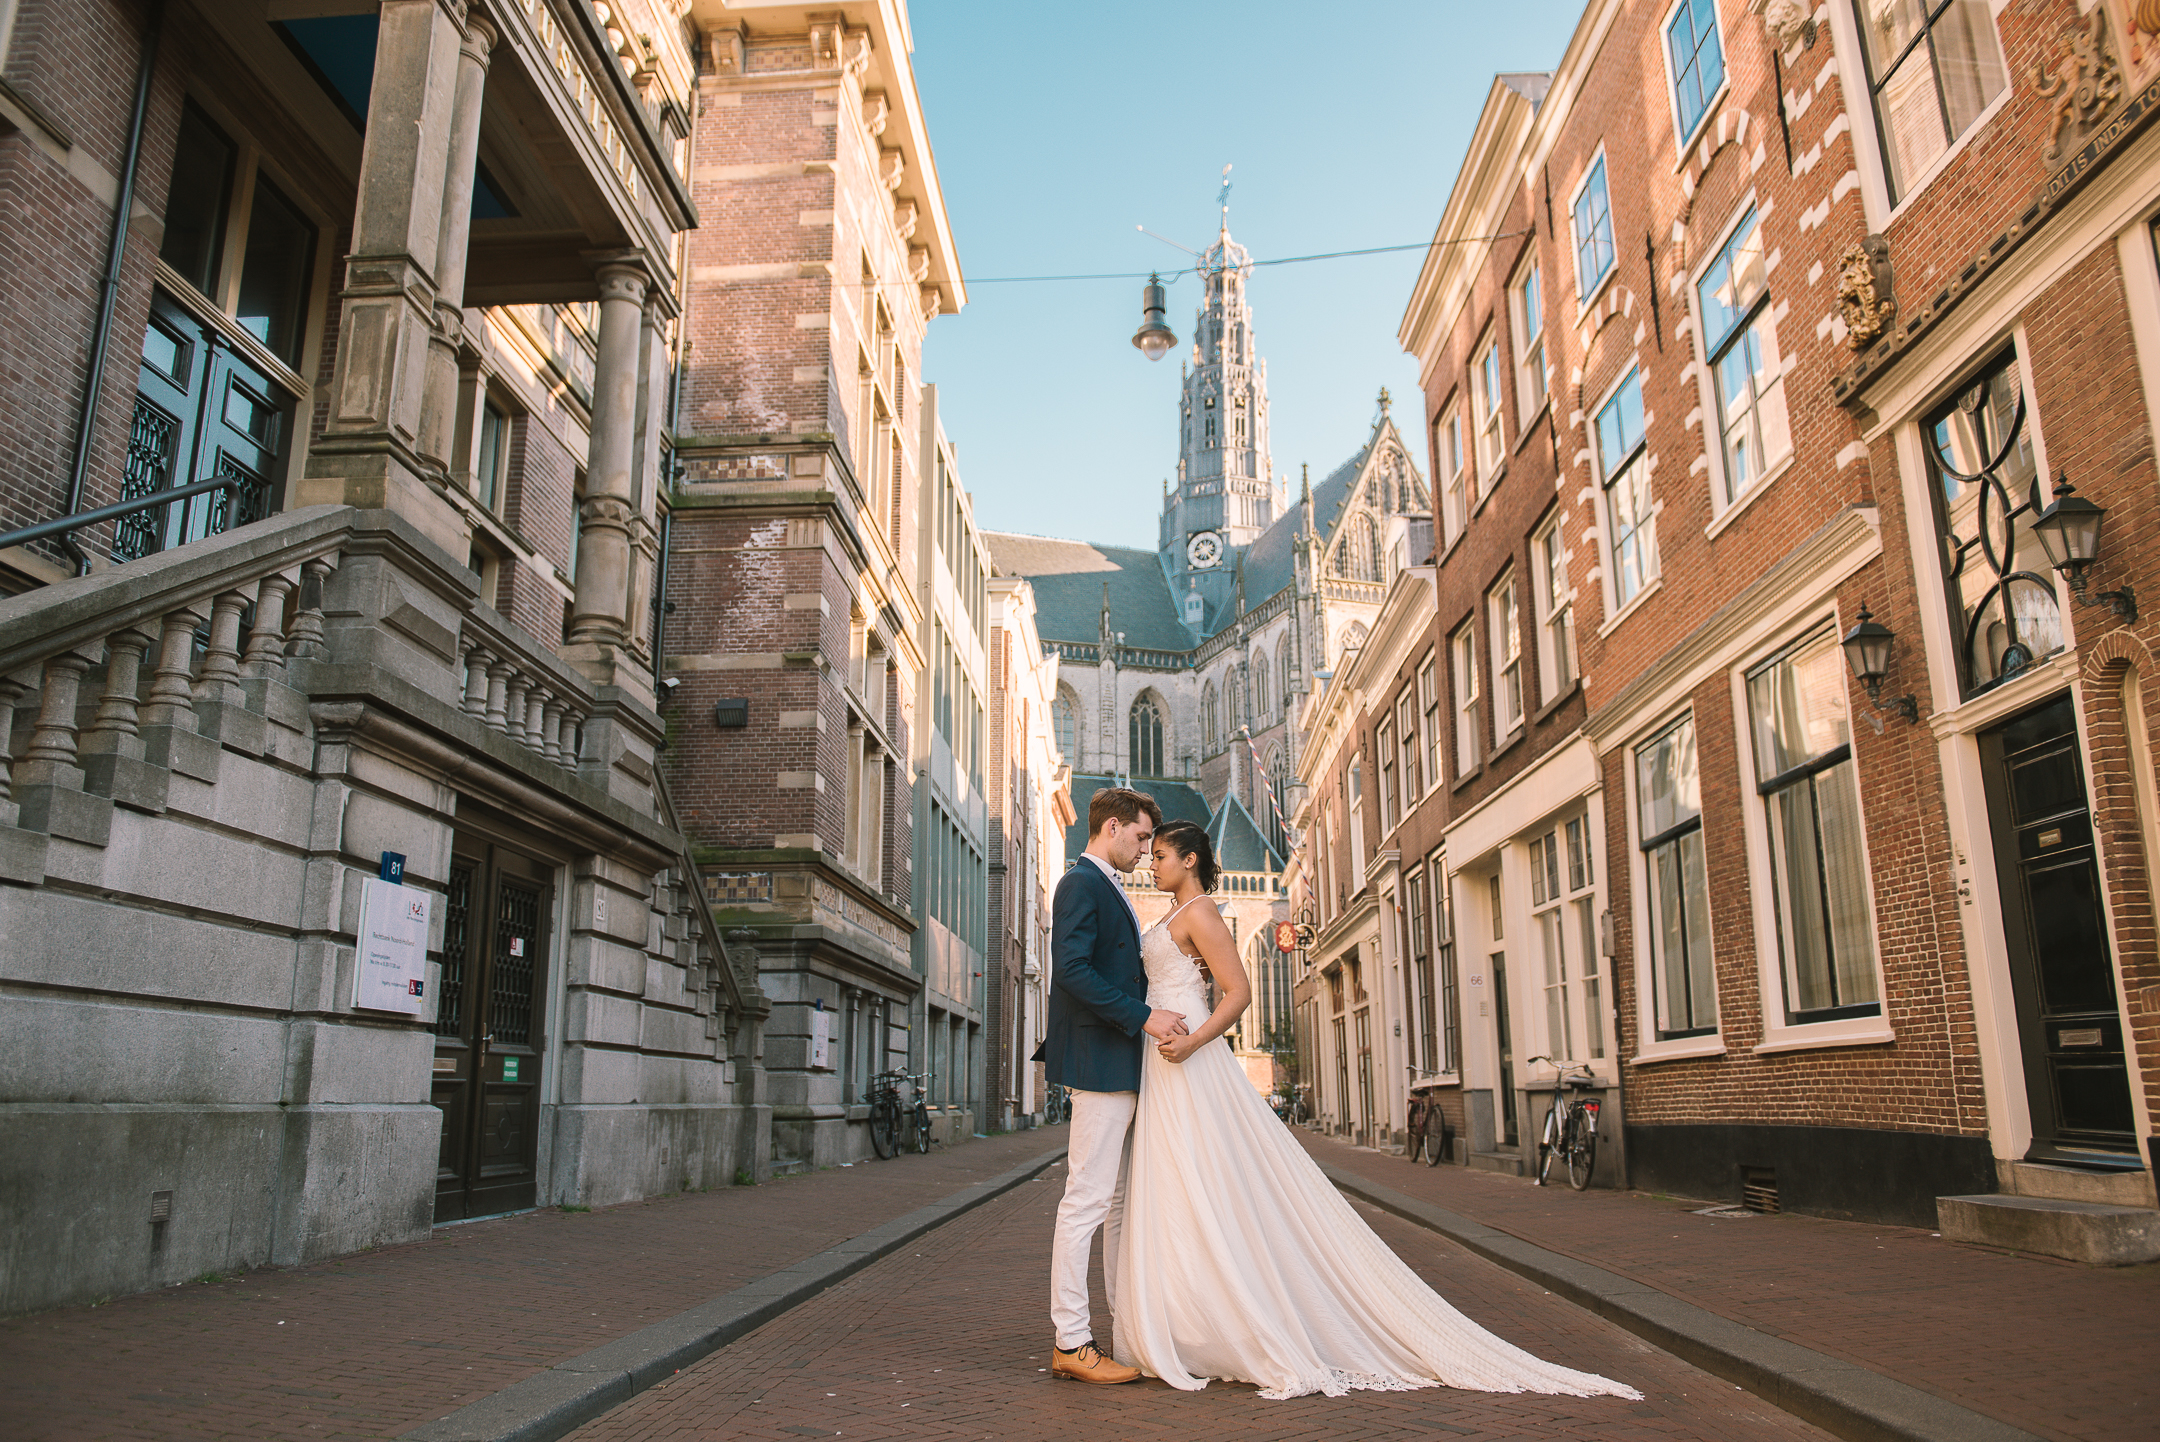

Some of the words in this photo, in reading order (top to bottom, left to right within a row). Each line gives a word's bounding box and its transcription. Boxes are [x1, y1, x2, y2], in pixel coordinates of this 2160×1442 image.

[2070, 152, 2088, 175] IS
[2135, 80, 2160, 111] TO
[390, 861, 402, 876] 81
[1470, 975, 1483, 986] 66
